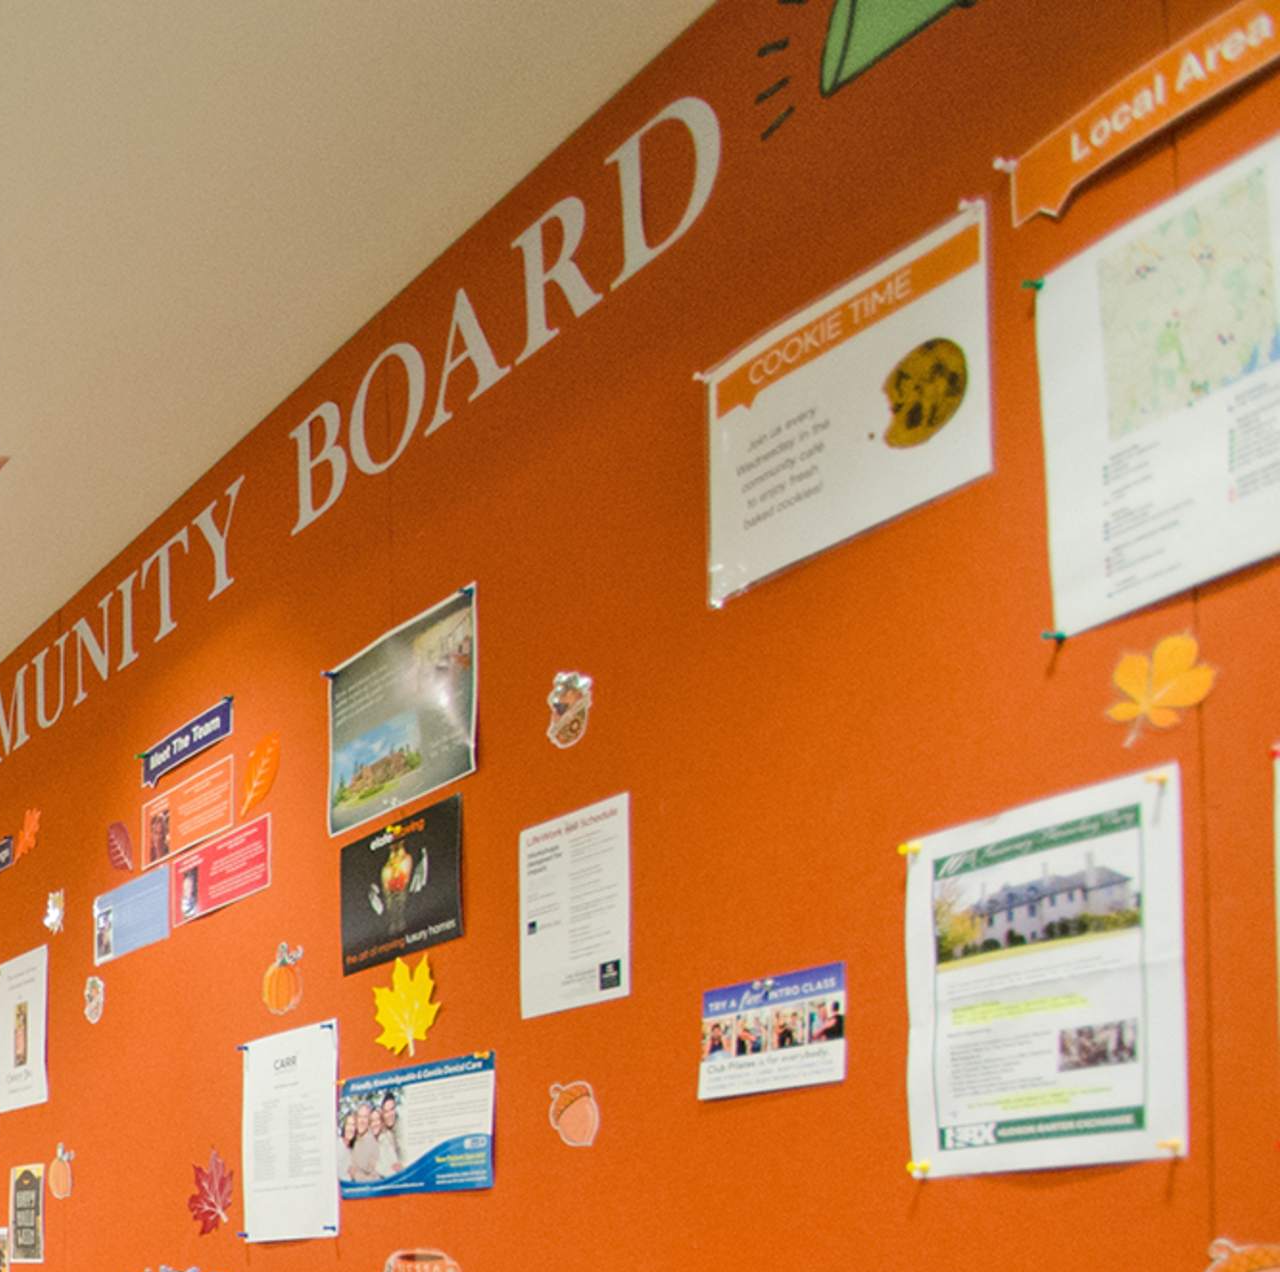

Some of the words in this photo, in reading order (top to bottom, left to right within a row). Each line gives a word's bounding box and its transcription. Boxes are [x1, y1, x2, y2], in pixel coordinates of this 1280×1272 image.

[1070, 73, 1165, 162] Local
[1175, 12, 1274, 93] Area
[288, 96, 722, 536] BOARD
[747, 310, 843, 385] COOKIE
[847, 267, 913, 325] TIME
[785, 407, 815, 430] every
[736, 439, 795, 476] Wednesday
[741, 457, 795, 493] community
[149, 745, 171, 770] Meet
[171, 734, 191, 755] The
[191, 716, 221, 742] Team
[406, 929, 428, 945] luxury
[428, 918, 457, 934] homes
[708, 1001, 727, 1013] TRY
[728, 999, 737, 1009] A
[768, 984, 801, 999] INTRO
[802, 976, 837, 994] CLASS
[273, 1055, 298, 1071] CARR
[444, 1063, 464, 1075] Dental
[464, 1060, 484, 1071] Care
